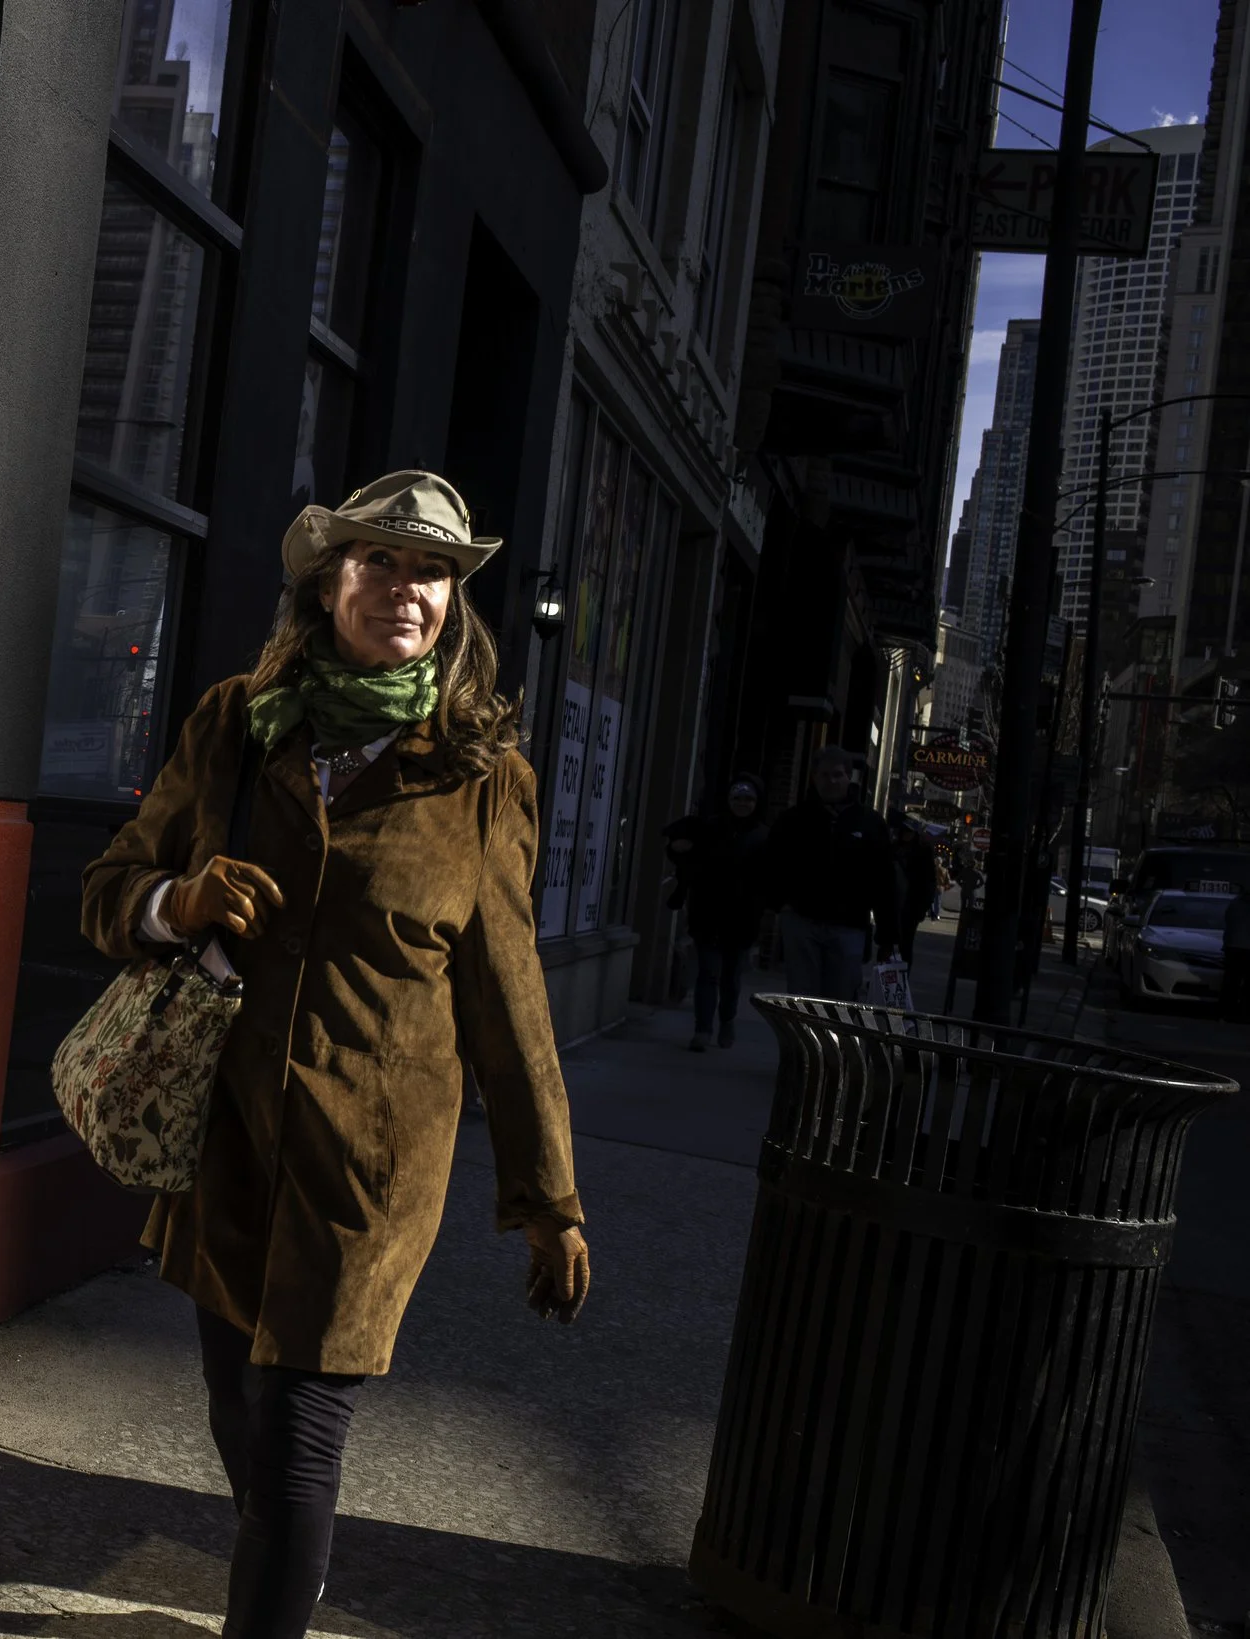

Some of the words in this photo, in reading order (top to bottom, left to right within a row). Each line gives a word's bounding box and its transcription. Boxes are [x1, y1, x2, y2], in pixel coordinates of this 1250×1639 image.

[1027, 164, 1141, 217] PRK
[972, 207, 1020, 238] EAST
[1081, 217, 1132, 243] EDAR
[562, 698, 587, 745] RETAIL
[597, 714, 612, 752] ACE
[561, 754, 579, 795] FOR
[591, 763, 606, 799] ASE
